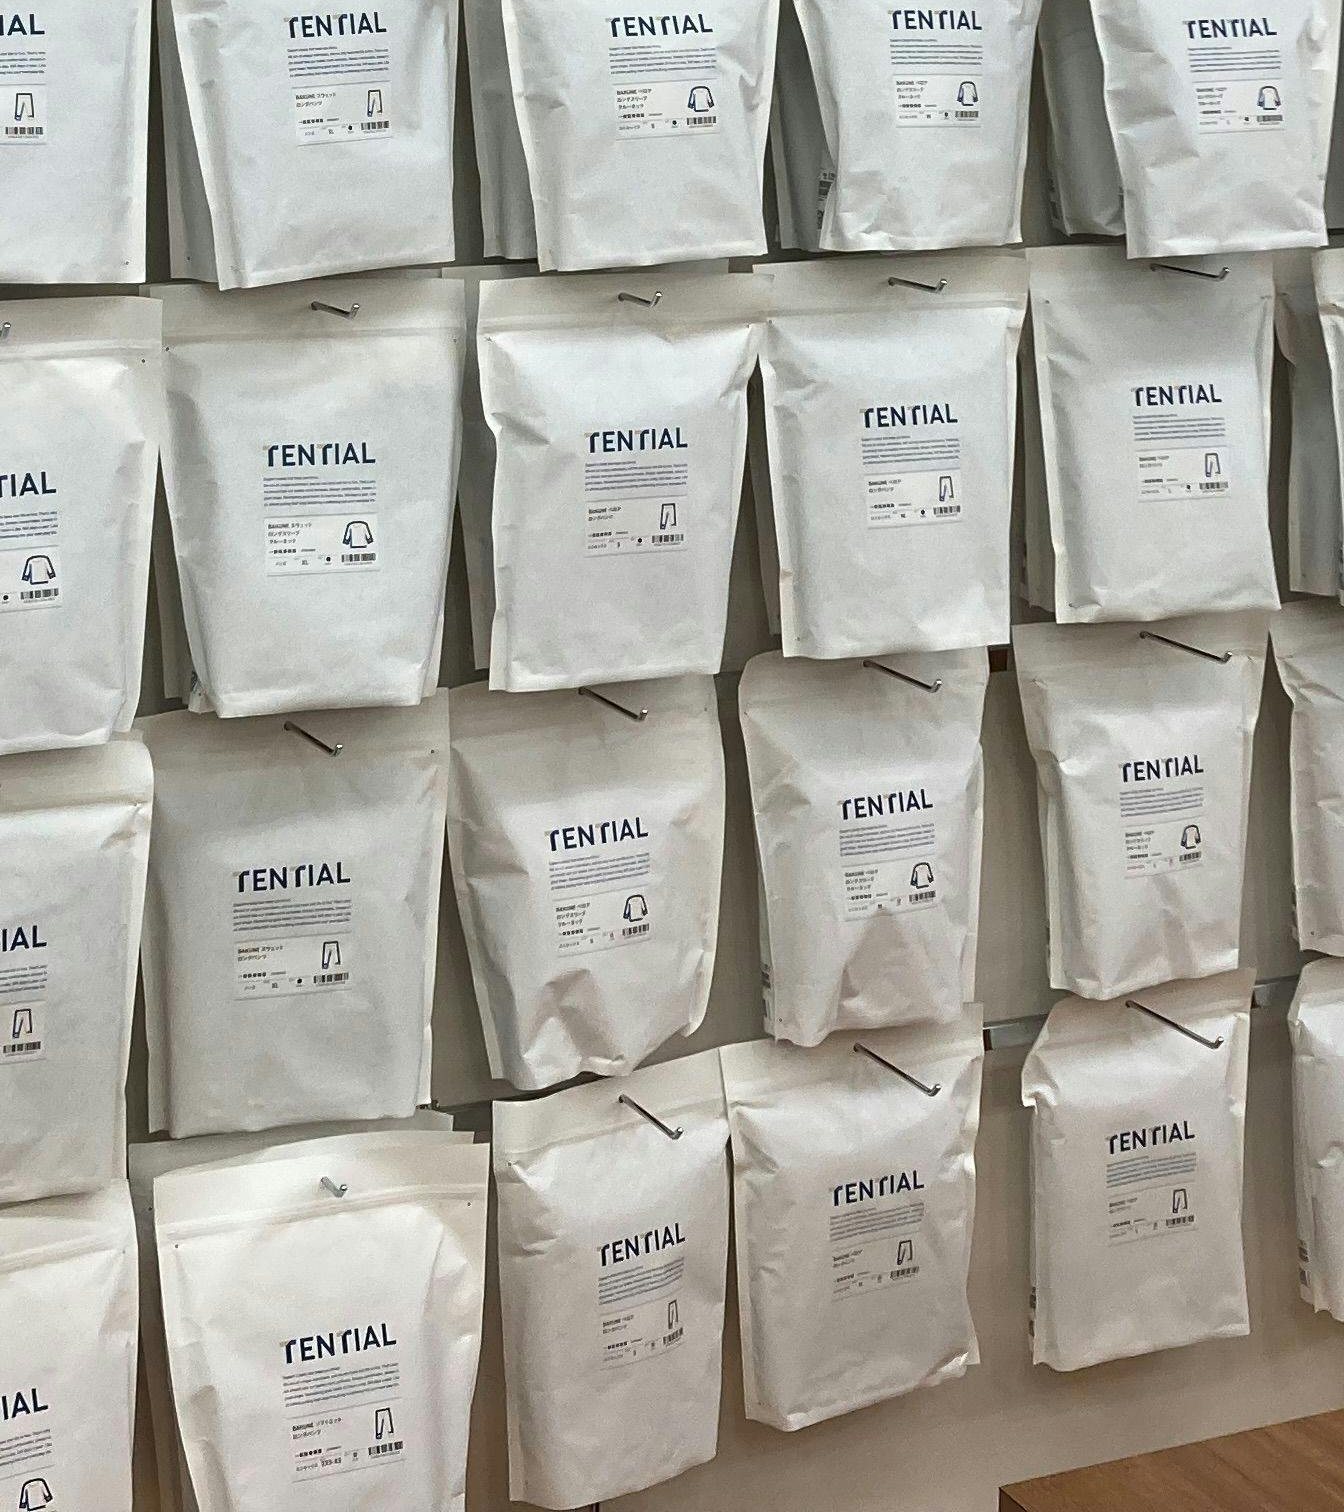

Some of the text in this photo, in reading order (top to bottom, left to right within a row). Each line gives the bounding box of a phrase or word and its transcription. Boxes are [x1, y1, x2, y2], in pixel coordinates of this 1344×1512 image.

[284, 12, 386, 38] TENTIAL
[606, 14, 713, 37] TENTIAL
[888, 10, 981, 30] TENTIAL
[1183, 18, 1276, 38] TENTIAL
[1132, 385, 1221, 406] TENTIAL
[860, 404, 957, 428] TENTIAL
[585, 428, 687, 453] TENTIAL
[262, 443, 375, 466] TENTIAL
[1119, 755, 1203, 782] TENTIAL
[838, 789, 933, 820] TENTIAL
[545, 818, 648, 851] TENTIAL
[233, 862, 350, 892] TENTIAL
[1102, 1121, 1195, 1154] TENTIAL
[829, 1170, 924, 1206] TENTIAL
[597, 1223, 685, 1266] TENTIAL
[280, 1324, 396, 1363] TENTIAL
